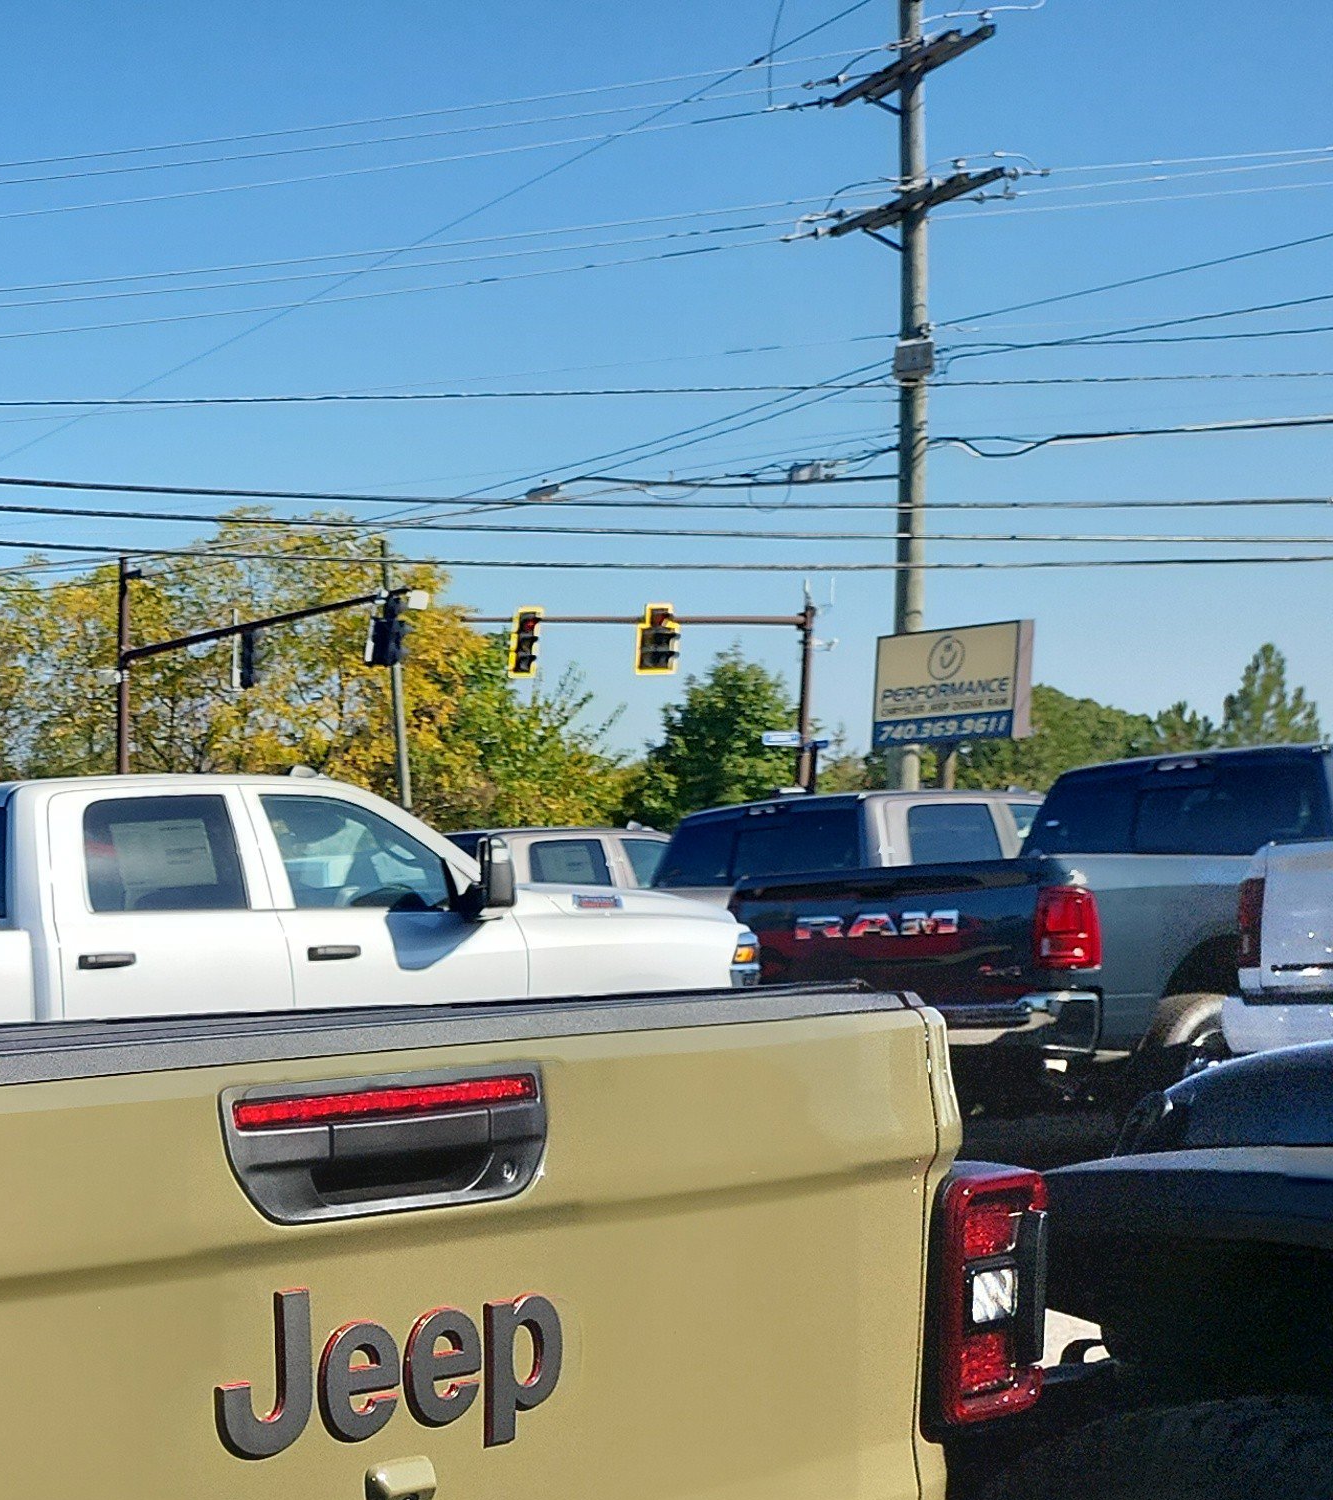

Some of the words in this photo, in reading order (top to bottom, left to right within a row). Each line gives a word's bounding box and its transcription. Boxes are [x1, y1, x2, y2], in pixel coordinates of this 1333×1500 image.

[883, 677, 1009, 701] PERFORMANCE
[878, 715, 1010, 742] 740.369.9611
[795, 910, 959, 939] RAM
[214, 1287, 563, 1460] Jeep
